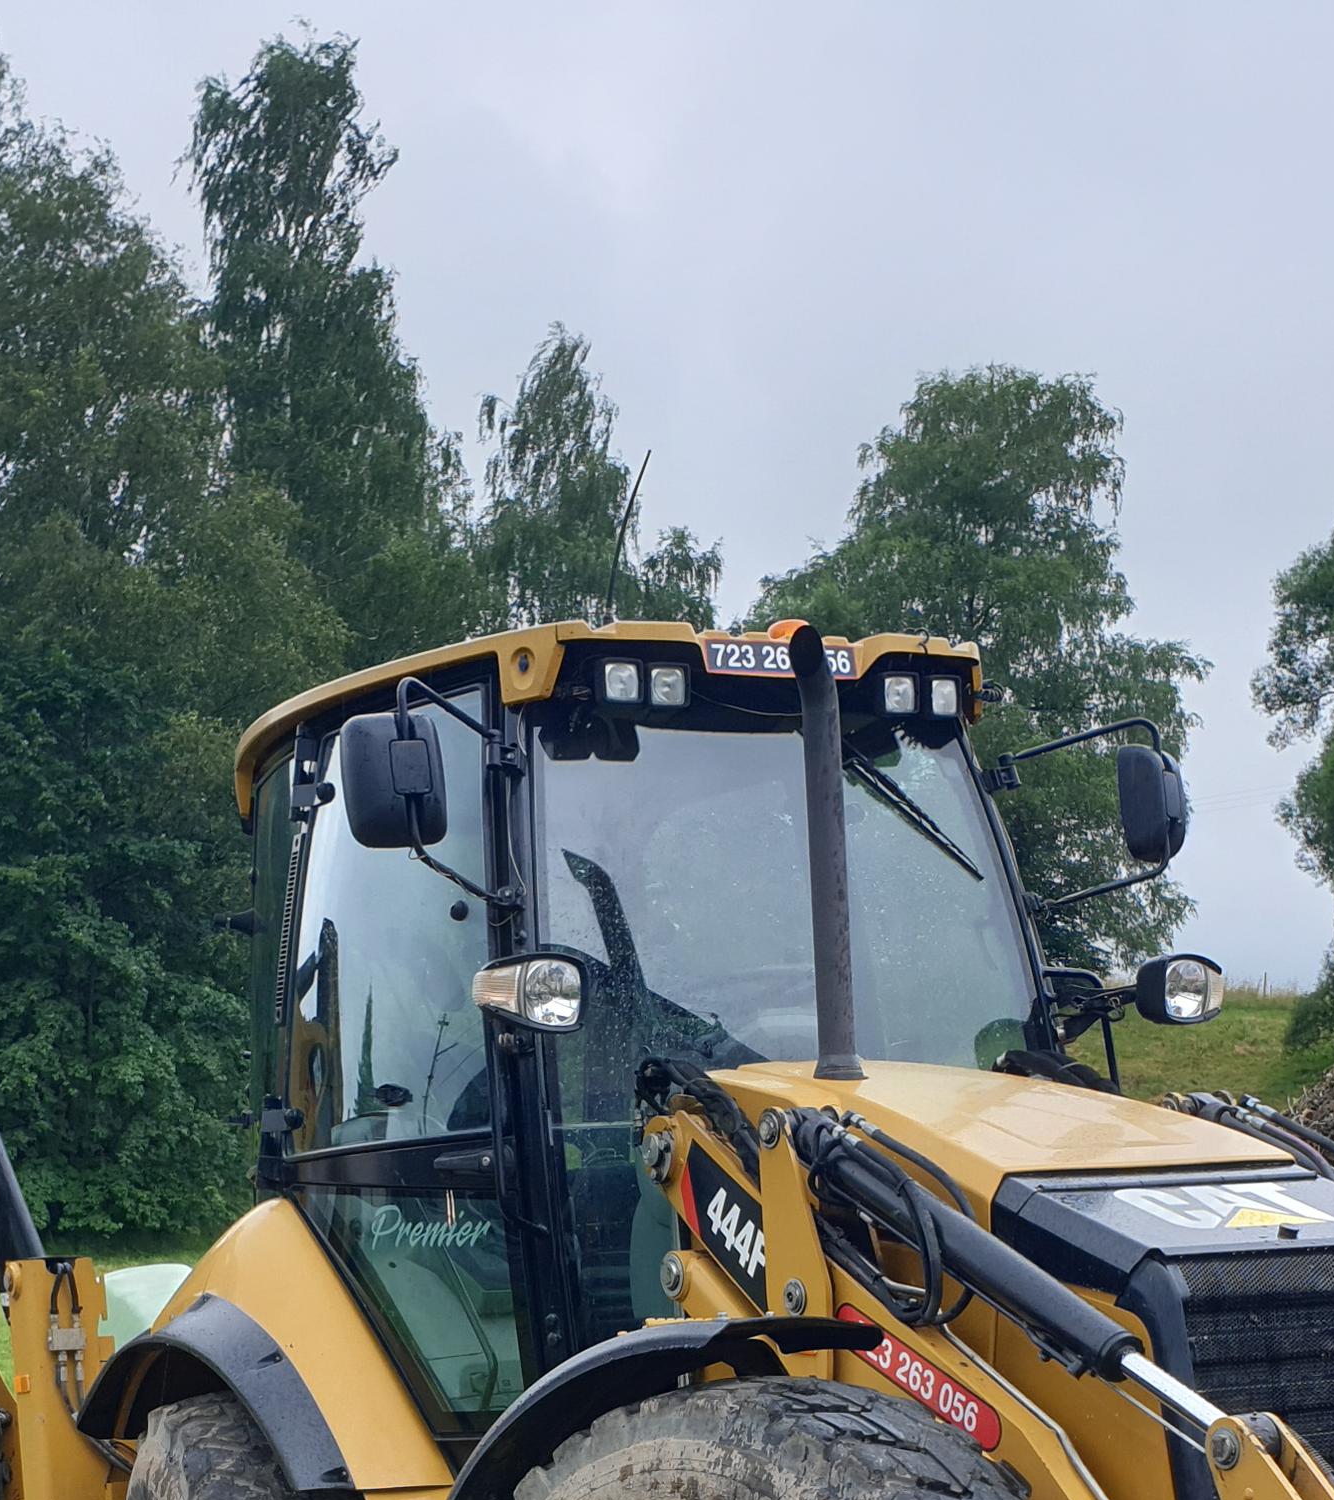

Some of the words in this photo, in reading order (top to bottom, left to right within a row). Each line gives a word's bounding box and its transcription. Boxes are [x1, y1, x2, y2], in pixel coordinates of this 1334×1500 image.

[710, 643, 756, 669] 723
[761, 645, 791, 670] 26
[825, 649, 851, 674] 56
[370, 1204, 492, 1251] Premier
[707, 1186, 767, 1279] 444F
[895, 1351, 935, 1400] 263
[938, 1382, 979, 1433] 056
